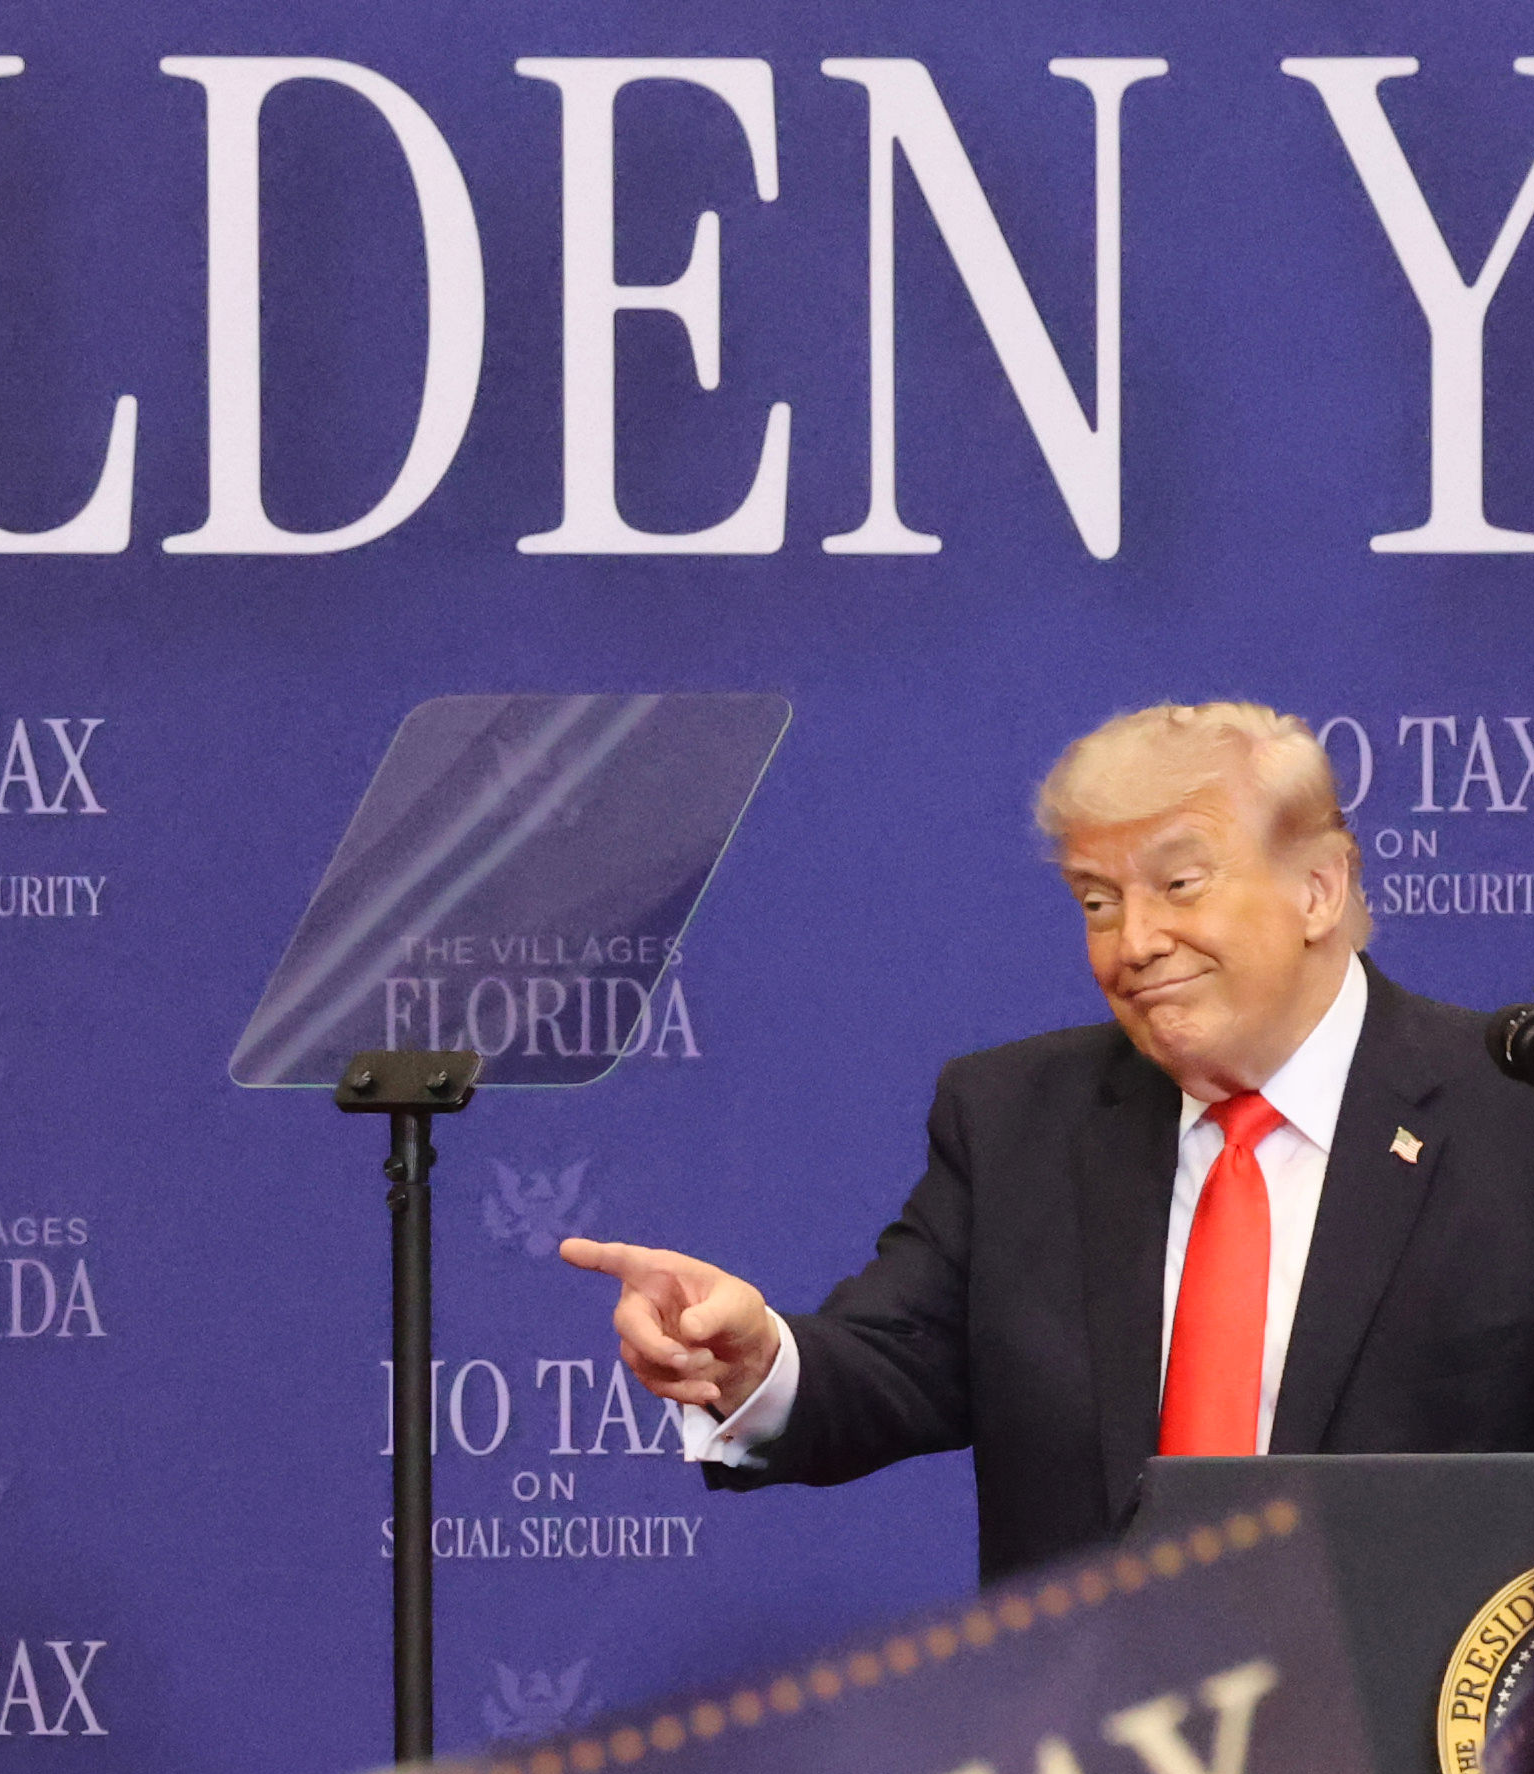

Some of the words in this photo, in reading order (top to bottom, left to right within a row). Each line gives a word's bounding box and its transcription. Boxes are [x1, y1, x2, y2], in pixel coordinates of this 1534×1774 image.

[1317, 716, 1373, 814] O
[1375, 828, 1436, 858] ON
[400, 936, 475, 965] THE
[490, 936, 685, 965] VILLAGES
[382, 976, 702, 1059] FLORIDA
[380, 1359, 510, 1456] O
[512, 1472, 574, 1501] ON
[381, 1517, 509, 1558] SCIAL
[520, 1517, 702, 1557] SECURITY
